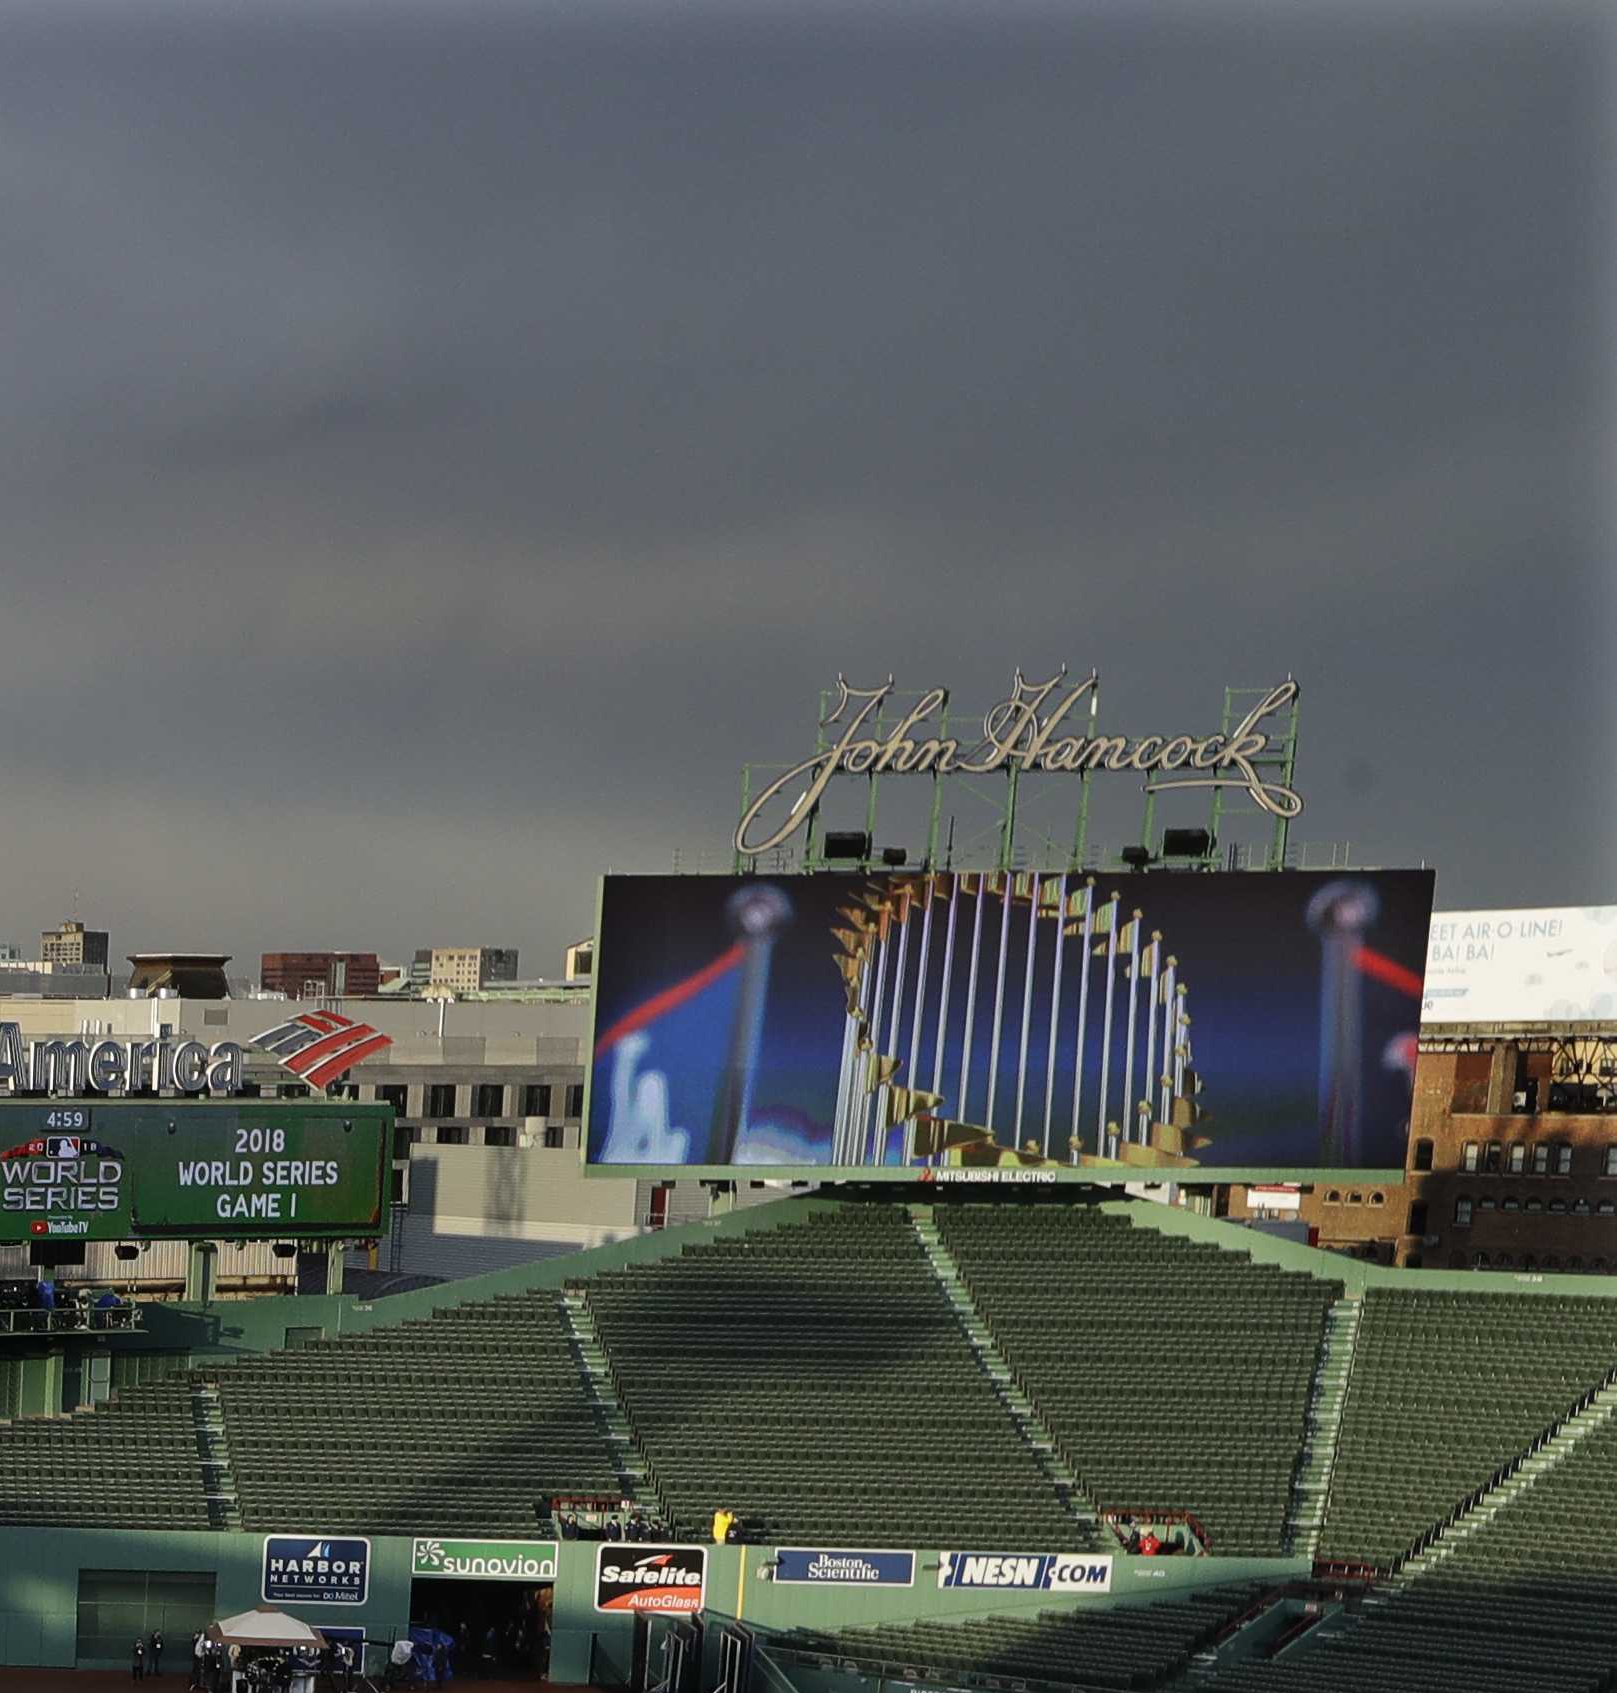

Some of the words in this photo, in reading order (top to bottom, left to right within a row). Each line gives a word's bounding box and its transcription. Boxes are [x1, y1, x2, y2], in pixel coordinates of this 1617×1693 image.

[734, 676, 957, 854] John
[956, 668, 1303, 818] Hancock
[47, 1112, 83, 1127] 4:59
[235, 1128, 285, 1153] 2018
[1, 1161, 122, 1184] WORLD
[178, 1161, 253, 1186] WORLD
[262, 1161, 338, 1185] SERIES
[936, 1171, 1000, 1182] MITSUBISHI
[1001, 1171, 1055, 1182] ELECTRIC
[3, 1187, 119, 1210] SERIES
[217, 1193, 281, 1218] GAME
[270, 1559, 362, 1574] HARBOR
[443, 1554, 553, 1575] sunovion
[808, 1562, 880, 1580] Scientific
[819, 1554, 863, 1568] Boston
[270, 1574, 360, 1585] NETWORKS
[601, 1565, 701, 1585] Safelite
[628, 1594, 699, 1609] AutoGlass
